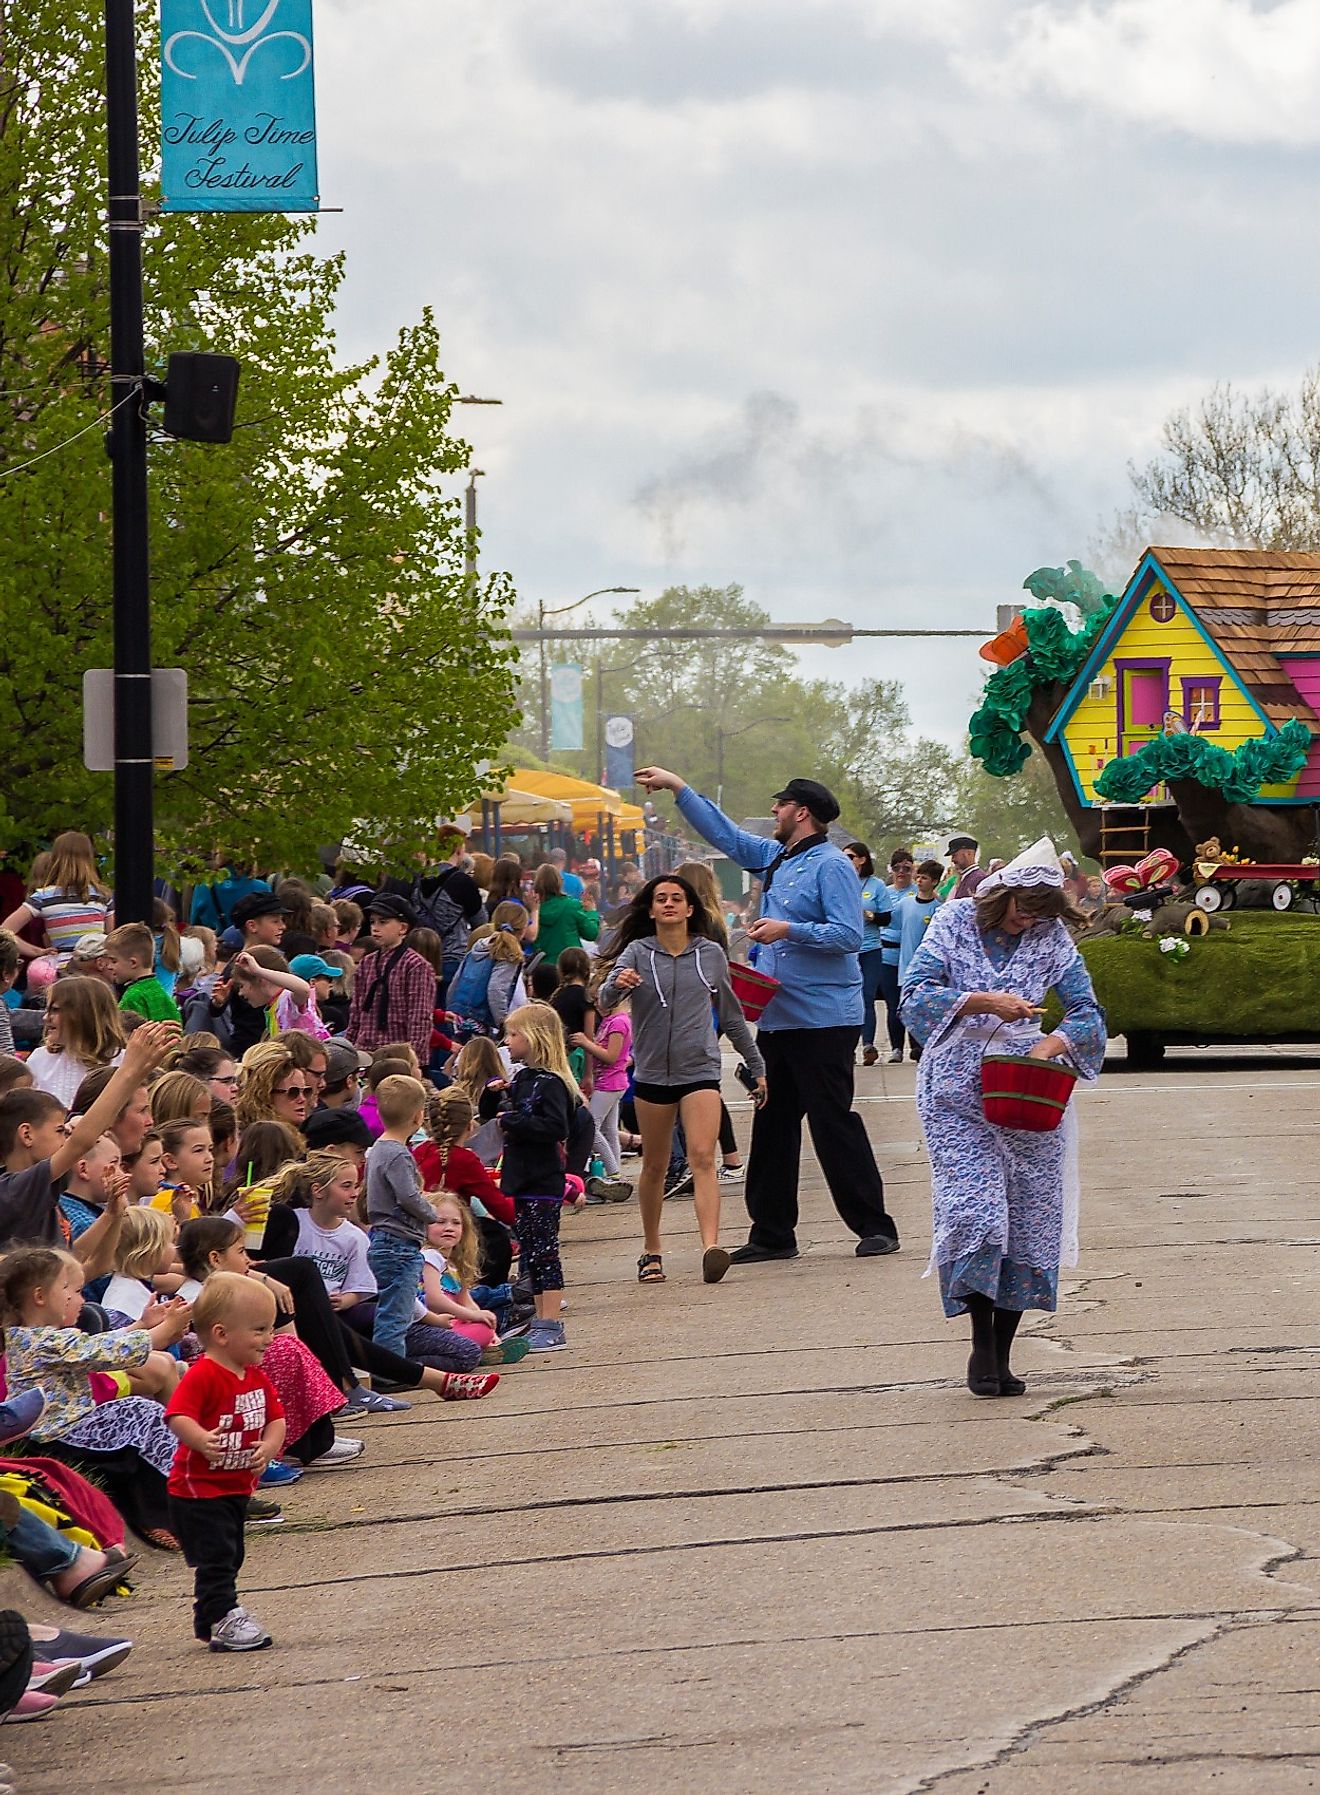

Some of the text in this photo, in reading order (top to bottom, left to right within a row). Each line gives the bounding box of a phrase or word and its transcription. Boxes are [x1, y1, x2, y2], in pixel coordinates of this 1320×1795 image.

[163, 112, 316, 157] Tulip Time
[184, 157, 303, 189] Festival
